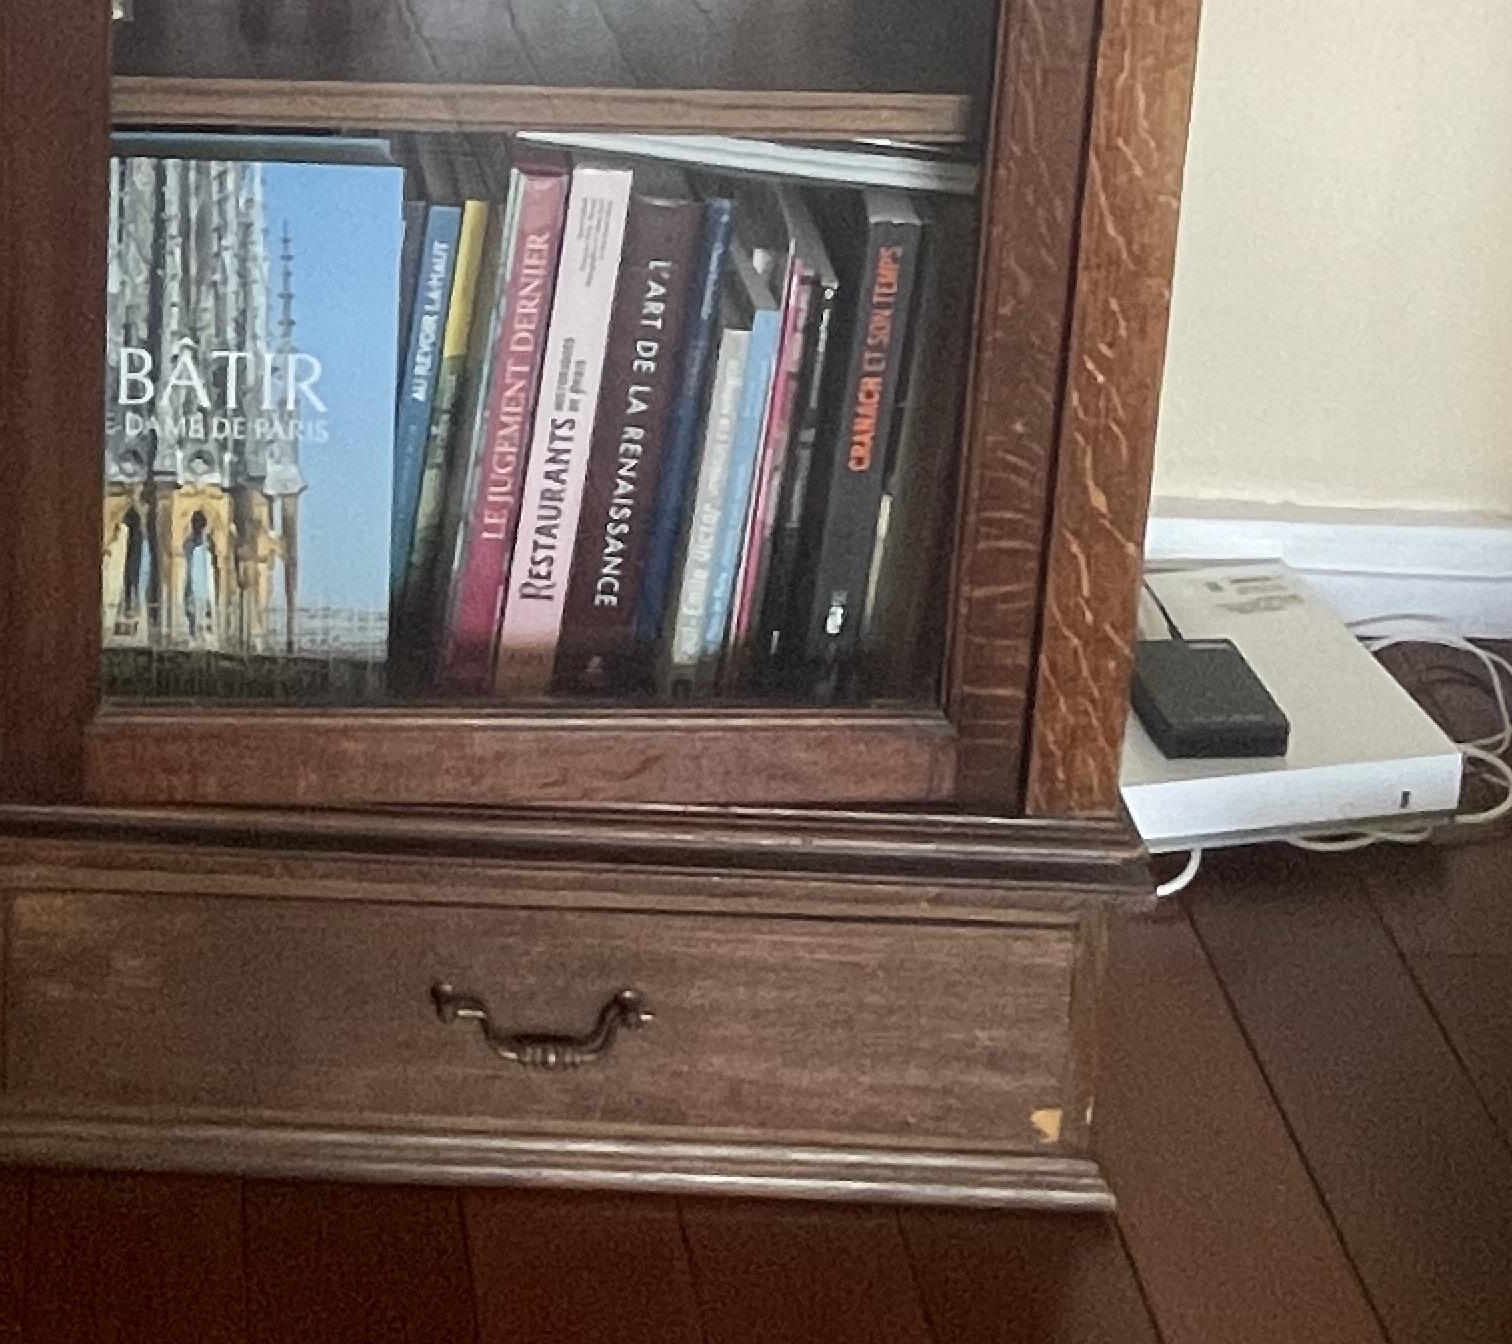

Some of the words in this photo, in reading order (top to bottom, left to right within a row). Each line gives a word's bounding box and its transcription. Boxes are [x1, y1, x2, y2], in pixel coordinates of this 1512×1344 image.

[513, 231, 552, 356] DERNIER
[640, 258, 673, 330] L'ART
[118, 336, 329, 412] BÂTIR
[633, 339, 660, 374] DE
[491, 362, 530, 505] JUGEMENT
[626, 386, 653, 414] LA
[481, 515, 507, 541] LE
[593, 426, 651, 608] RENAISSANCE
